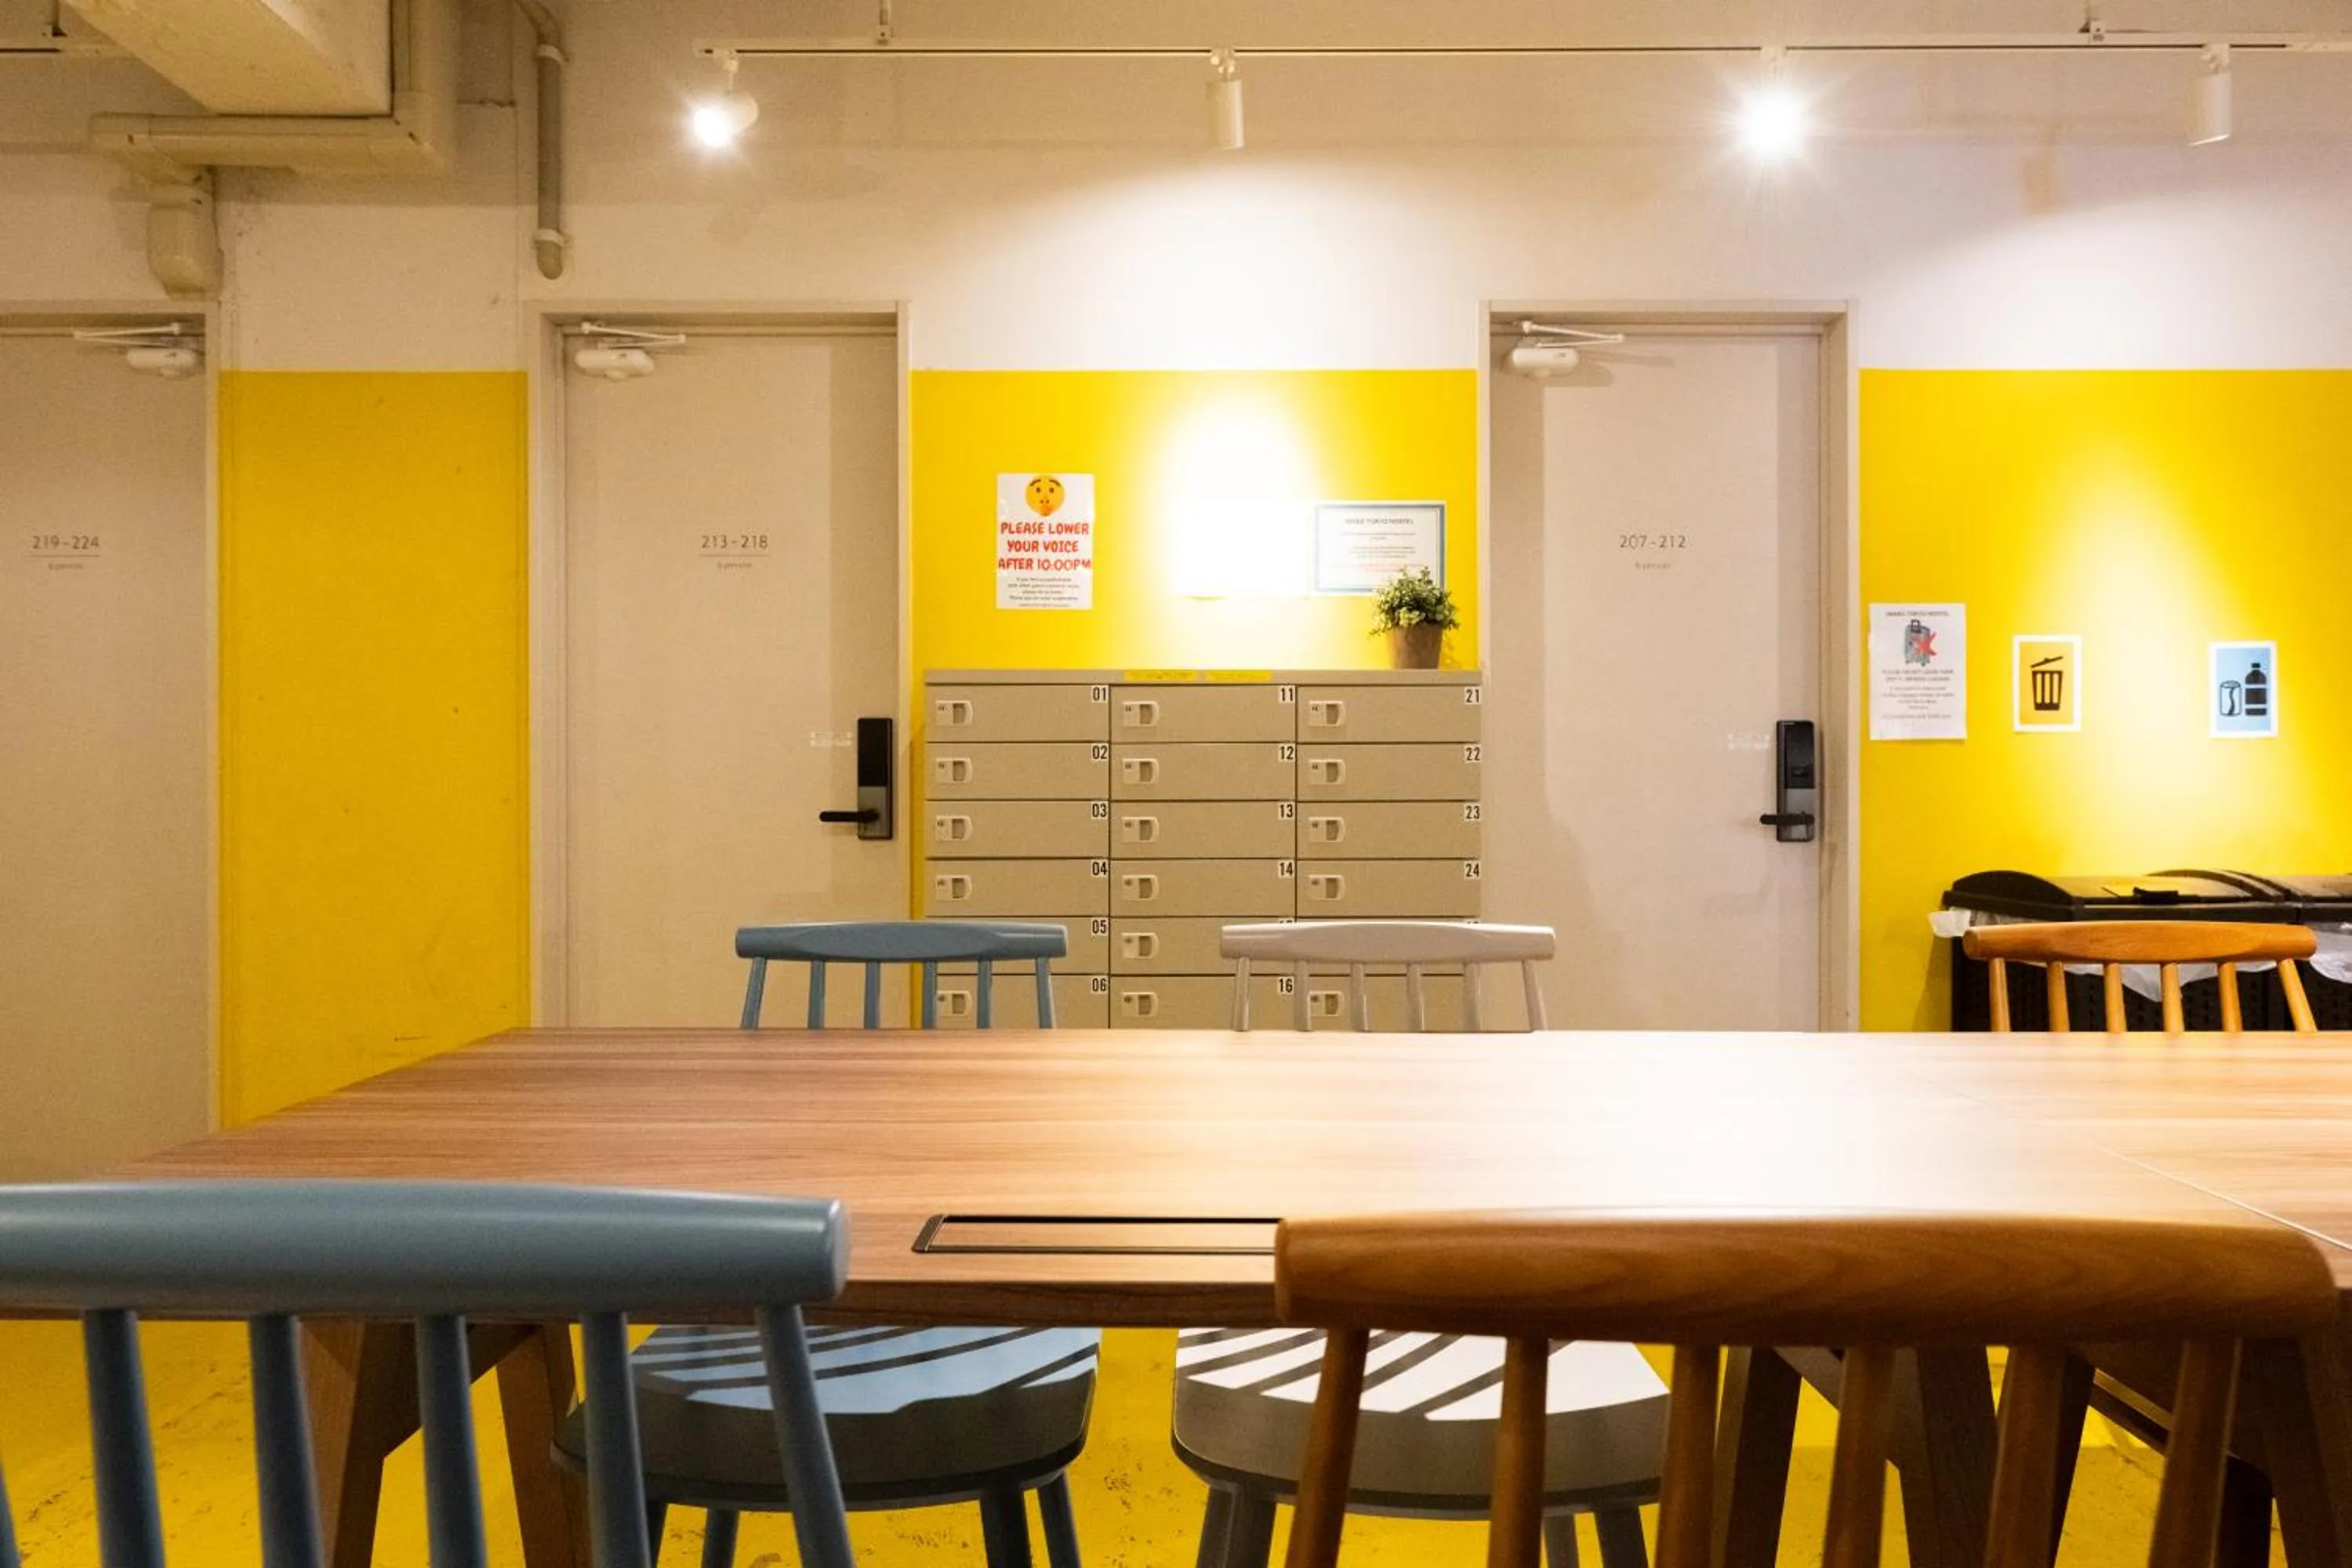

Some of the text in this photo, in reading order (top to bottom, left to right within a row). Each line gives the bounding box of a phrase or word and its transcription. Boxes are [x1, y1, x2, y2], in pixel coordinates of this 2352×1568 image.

[1000, 521, 1089, 535] PLEASE LOWER
[702, 534, 768, 549] 213-218
[1007, 540, 1079, 552] YOUR VOICE
[1620, 534, 1686, 550] 207-212
[998, 557, 1033, 570] AFTER
[1092, 687, 1107, 701] 01
[1280, 688, 1293, 702] 11
[1465, 689, 1480, 703] 21
[1092, 746, 1107, 760] 02
[1279, 746, 1294, 760] 12
[1465, 747, 1480, 760] 22
[1092, 804, 1107, 818] 03
[1279, 804, 1293, 818] 13
[1465, 806, 1480, 819] 23
[1092, 862, 1107, 876] 04
[1279, 862, 1293, 876] 14
[1465, 863, 1480, 877] 24
[1092, 920, 1106, 934] 05
[1092, 978, 1106, 992] 06
[1279, 978, 1293, 993] 16
